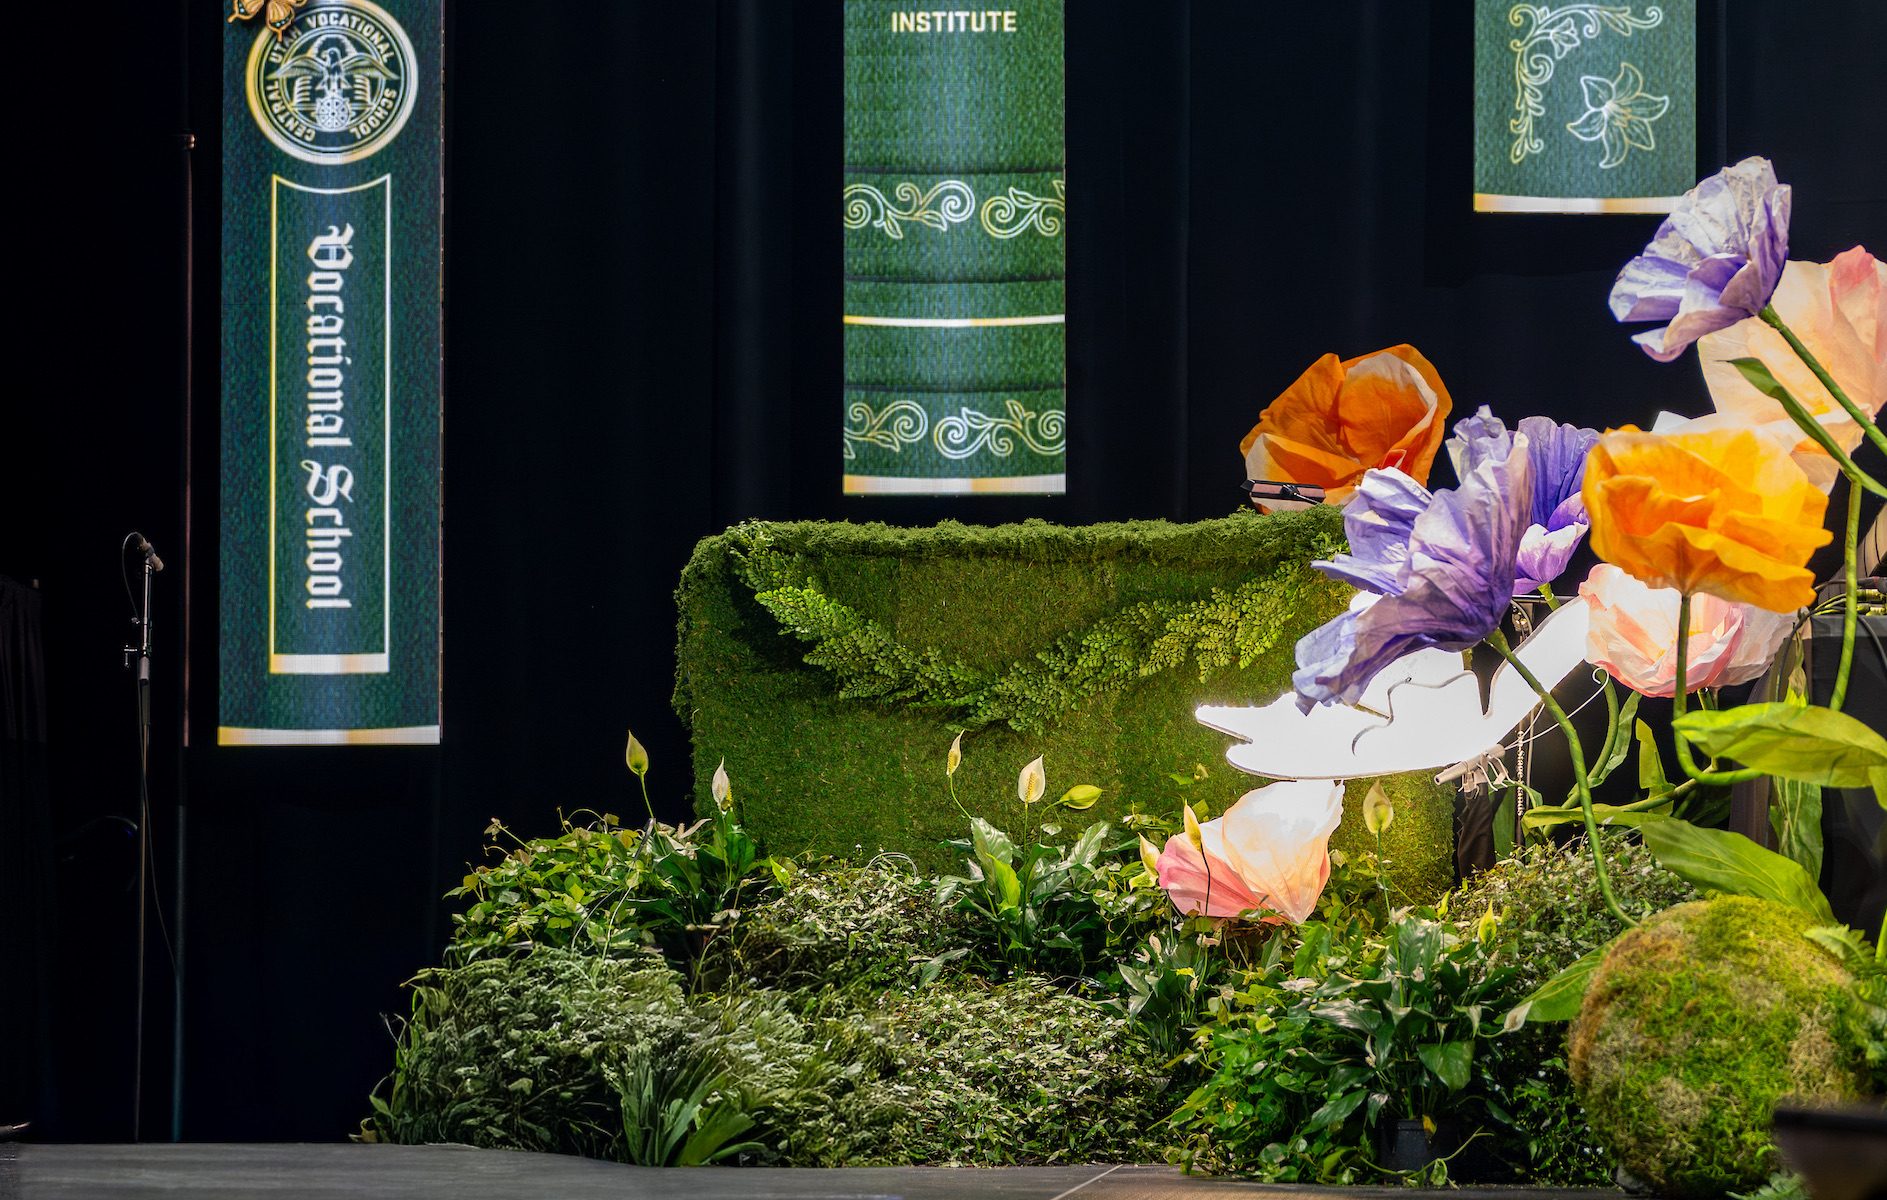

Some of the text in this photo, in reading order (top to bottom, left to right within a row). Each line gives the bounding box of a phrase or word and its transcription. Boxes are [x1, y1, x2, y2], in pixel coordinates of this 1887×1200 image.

[267, 81, 315, 142] CENTRAL
[306, 12, 394, 64] VOCATIONAL
[350, 88, 397, 139] SCHOOL
[891, 11, 1017, 33] INSTITUTE
[300, 223, 355, 609] Vocational School
